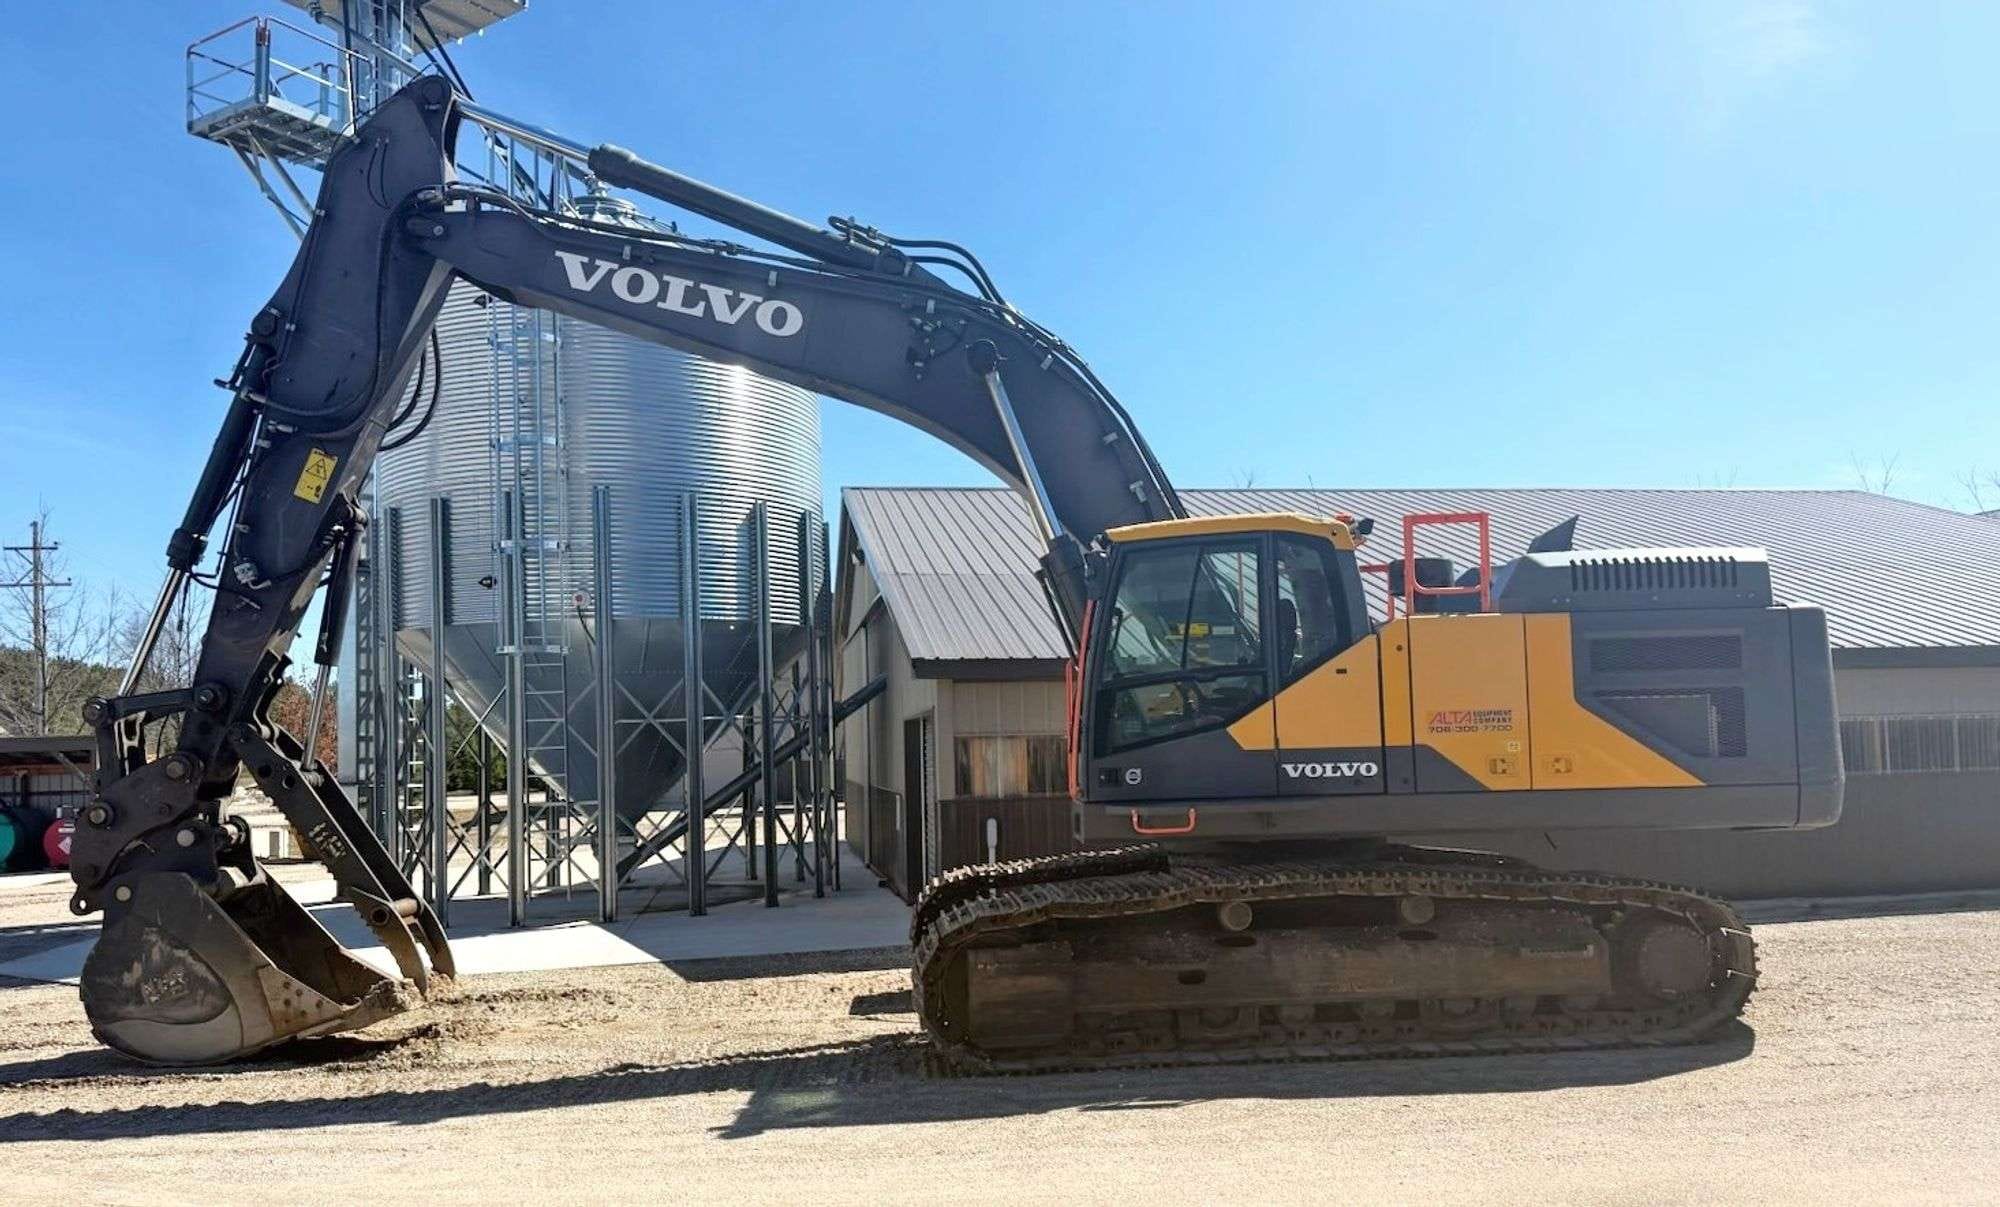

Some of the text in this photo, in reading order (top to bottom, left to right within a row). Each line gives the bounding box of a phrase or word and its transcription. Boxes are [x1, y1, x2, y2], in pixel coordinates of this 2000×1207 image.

[554, 250, 803, 337] VOLVO
[1429, 711, 1472, 725] ALTA
[1281, 762, 1378, 778] VOLVO
